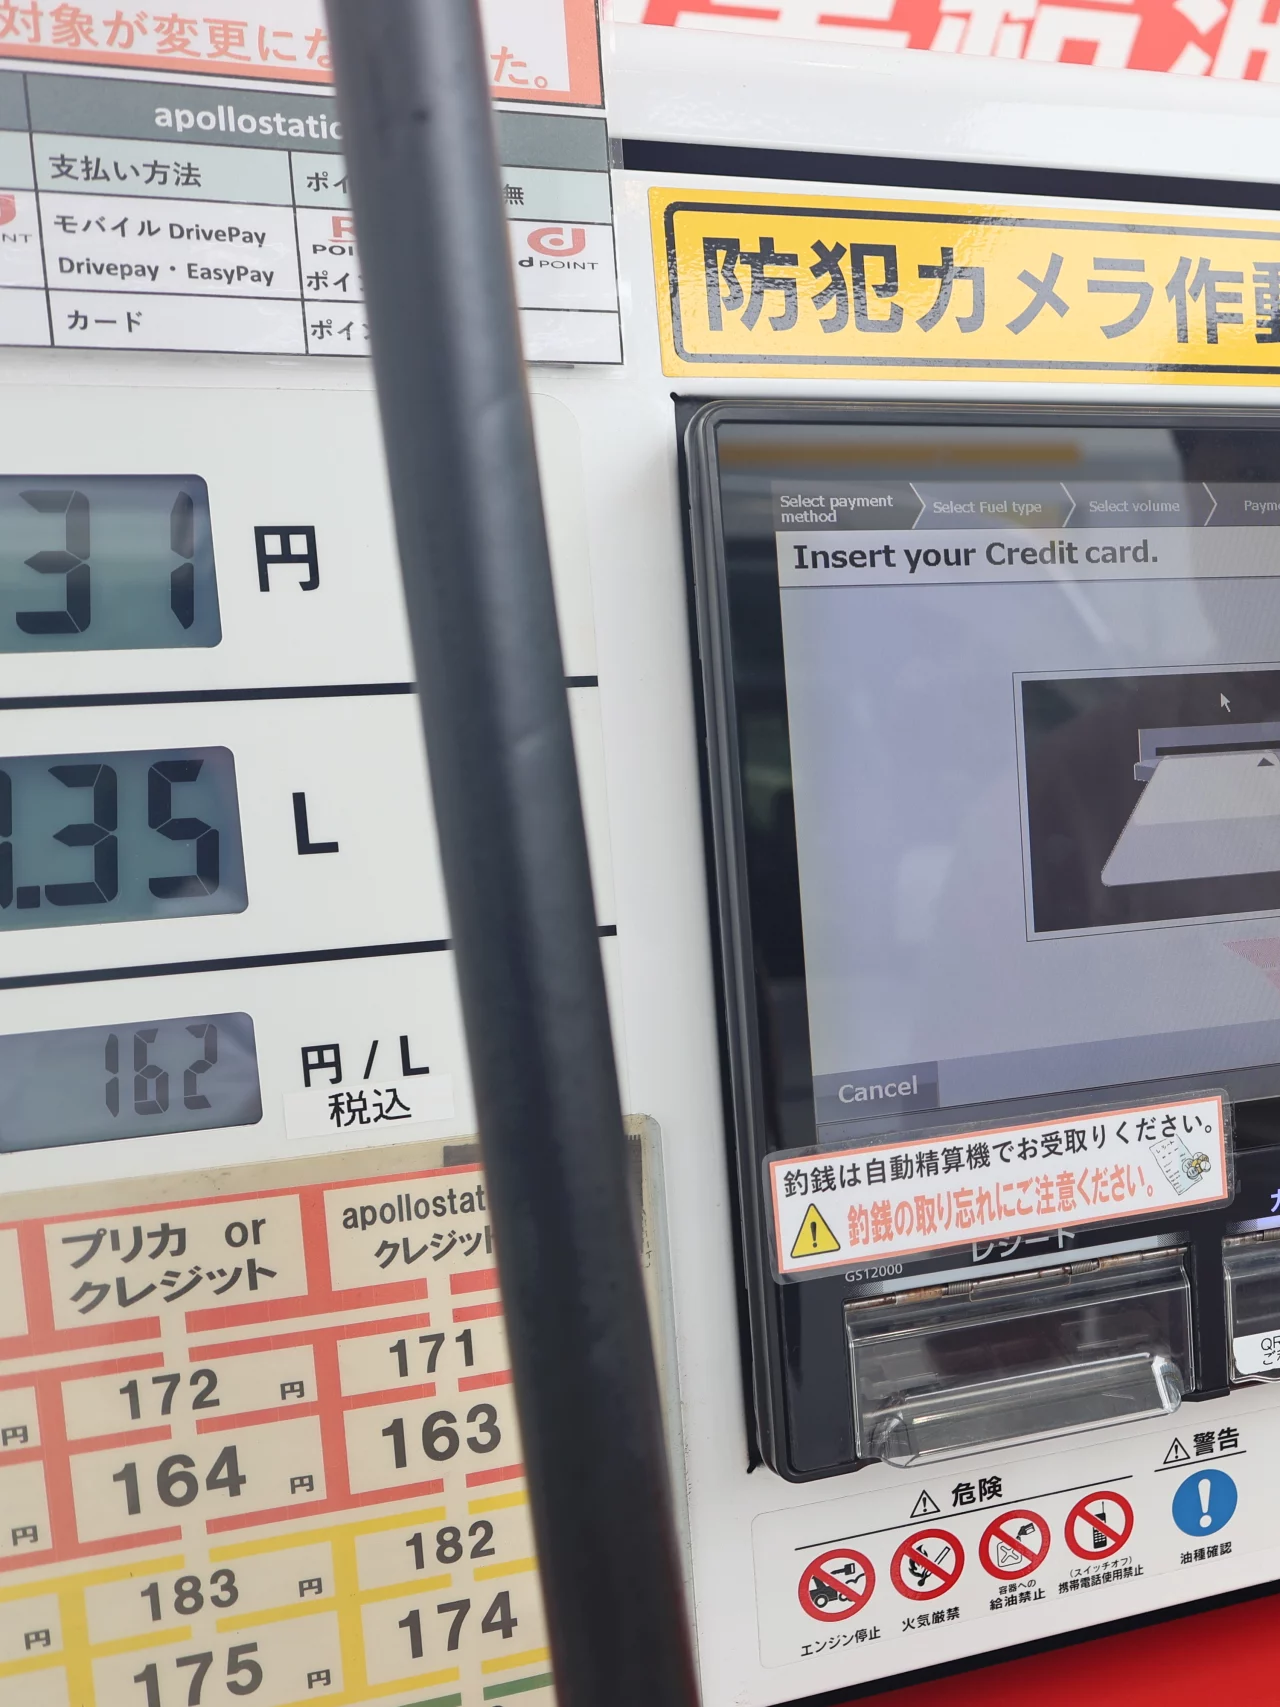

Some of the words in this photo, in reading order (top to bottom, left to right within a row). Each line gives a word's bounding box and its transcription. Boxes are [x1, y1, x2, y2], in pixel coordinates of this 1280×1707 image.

[49, 154, 202, 188] 支払い方法
[54, 214, 161, 238] モバイル
[169, 223, 266, 248] DrivePay
[58, 256, 159, 283] Drivepay
[187, 262, 275, 287] EasyPay
[540, 260, 598, 270] POINT
[67, 310, 143, 334] カード
[780, 495, 824, 508] Select
[829, 495, 893, 510] payment
[781, 509, 837, 523] method
[933, 501, 975, 514] Select
[979, 501, 1008, 514] Fuel
[1013, 502, 1042, 516] type
[1089, 500, 1132, 512] Select
[1137, 500, 1180, 512] volume
[254, 525, 320, 592] 円
[793, 544, 896, 569] Insert
[904, 546, 976, 573] your
[986, 541, 1078, 566] Credit
[1085, 539, 1159, 564] card.
[292, 792, 340, 855] L
[104, 1023, 218, 1118] 162
[838, 1075, 918, 1104] Cancel
[328, 1087, 412, 1128] 税込
[783, 1112, 1213, 1198] 釣銭は自動精算機でお受取りください。
[847, 1163, 1154, 1247] 釣銭の取り忘れにご注意ください。
[61, 1222, 187, 1268] プリカ
[224, 1215, 266, 1249] or
[971, 1228, 1076, 1262] レシート
[69, 1258, 277, 1314] クレジット
[845, 1262, 903, 1283] GS12000
[389, 1328, 475, 1377] 171
[118, 1369, 221, 1419] 172
[280, 1382, 305, 1400] 円
[382, 1403, 501, 1469] 163
[1193, 1426, 1240, 1457] 警告
[112, 1445, 247, 1516] 164
[289, 1474, 315, 1495] 円
[951, 1476, 1003, 1507] 危険
[11, 1524, 39, 1546] 円
[405, 1520, 496, 1571] 182
[1180, 1541, 1233, 1565] 油種確認
[140, 1568, 240, 1622] 183
[299, 1577, 324, 1597] 円
[998, 1579, 1037, 1596] 容器への
[1058, 1564, 1145, 1594] 携帯電話使用禁止
[989, 1588, 1046, 1611] 給油禁止
[398, 1590, 519, 1660] 174
[901, 1605, 961, 1632] 火気厳禁
[24, 1628, 52, 1651] 円
[800, 1627, 881, 1657] エンジン停止
[132, 1642, 264, 1707] 175
[306, 1669, 332, 1689] 円
